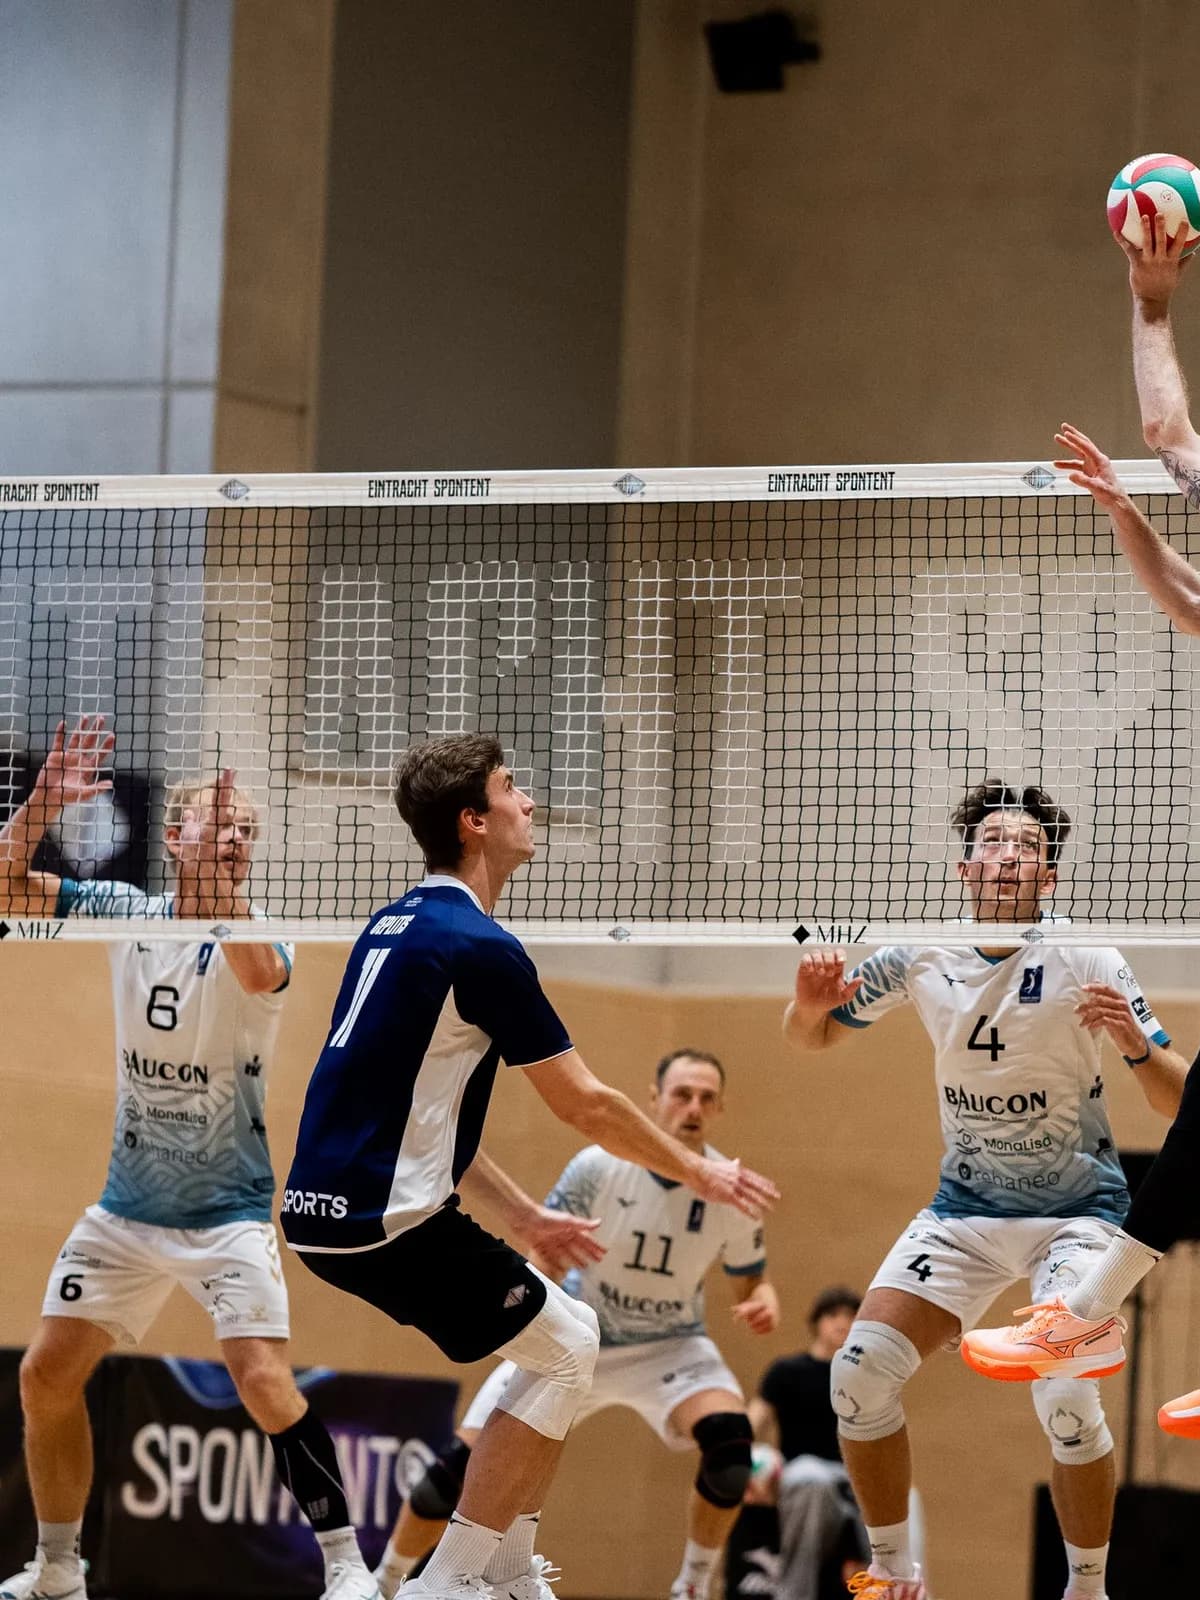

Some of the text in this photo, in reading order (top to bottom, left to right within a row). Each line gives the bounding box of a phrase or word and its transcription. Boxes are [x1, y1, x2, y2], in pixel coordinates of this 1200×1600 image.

[44, 482, 100, 501] SPONTENT
[368, 477, 492, 498] EINTRACHT SPONTENT
[768, 471, 896, 493] EINTRACHT SPONTENT
[17, 921, 64, 940] MHZ
[817, 925, 867, 944] MHZ
[147, 985, 179, 1031] 6
[329, 947, 392, 1048] 11
[967, 1014, 1005, 1062] 4
[944, 1083, 1047, 1119] BAUCON
[983, 1135, 1053, 1152] MonaLisa
[624, 1230, 675, 1277] 11
[907, 1253, 933, 1282] 4
[60, 1274, 85, 1302] 6
